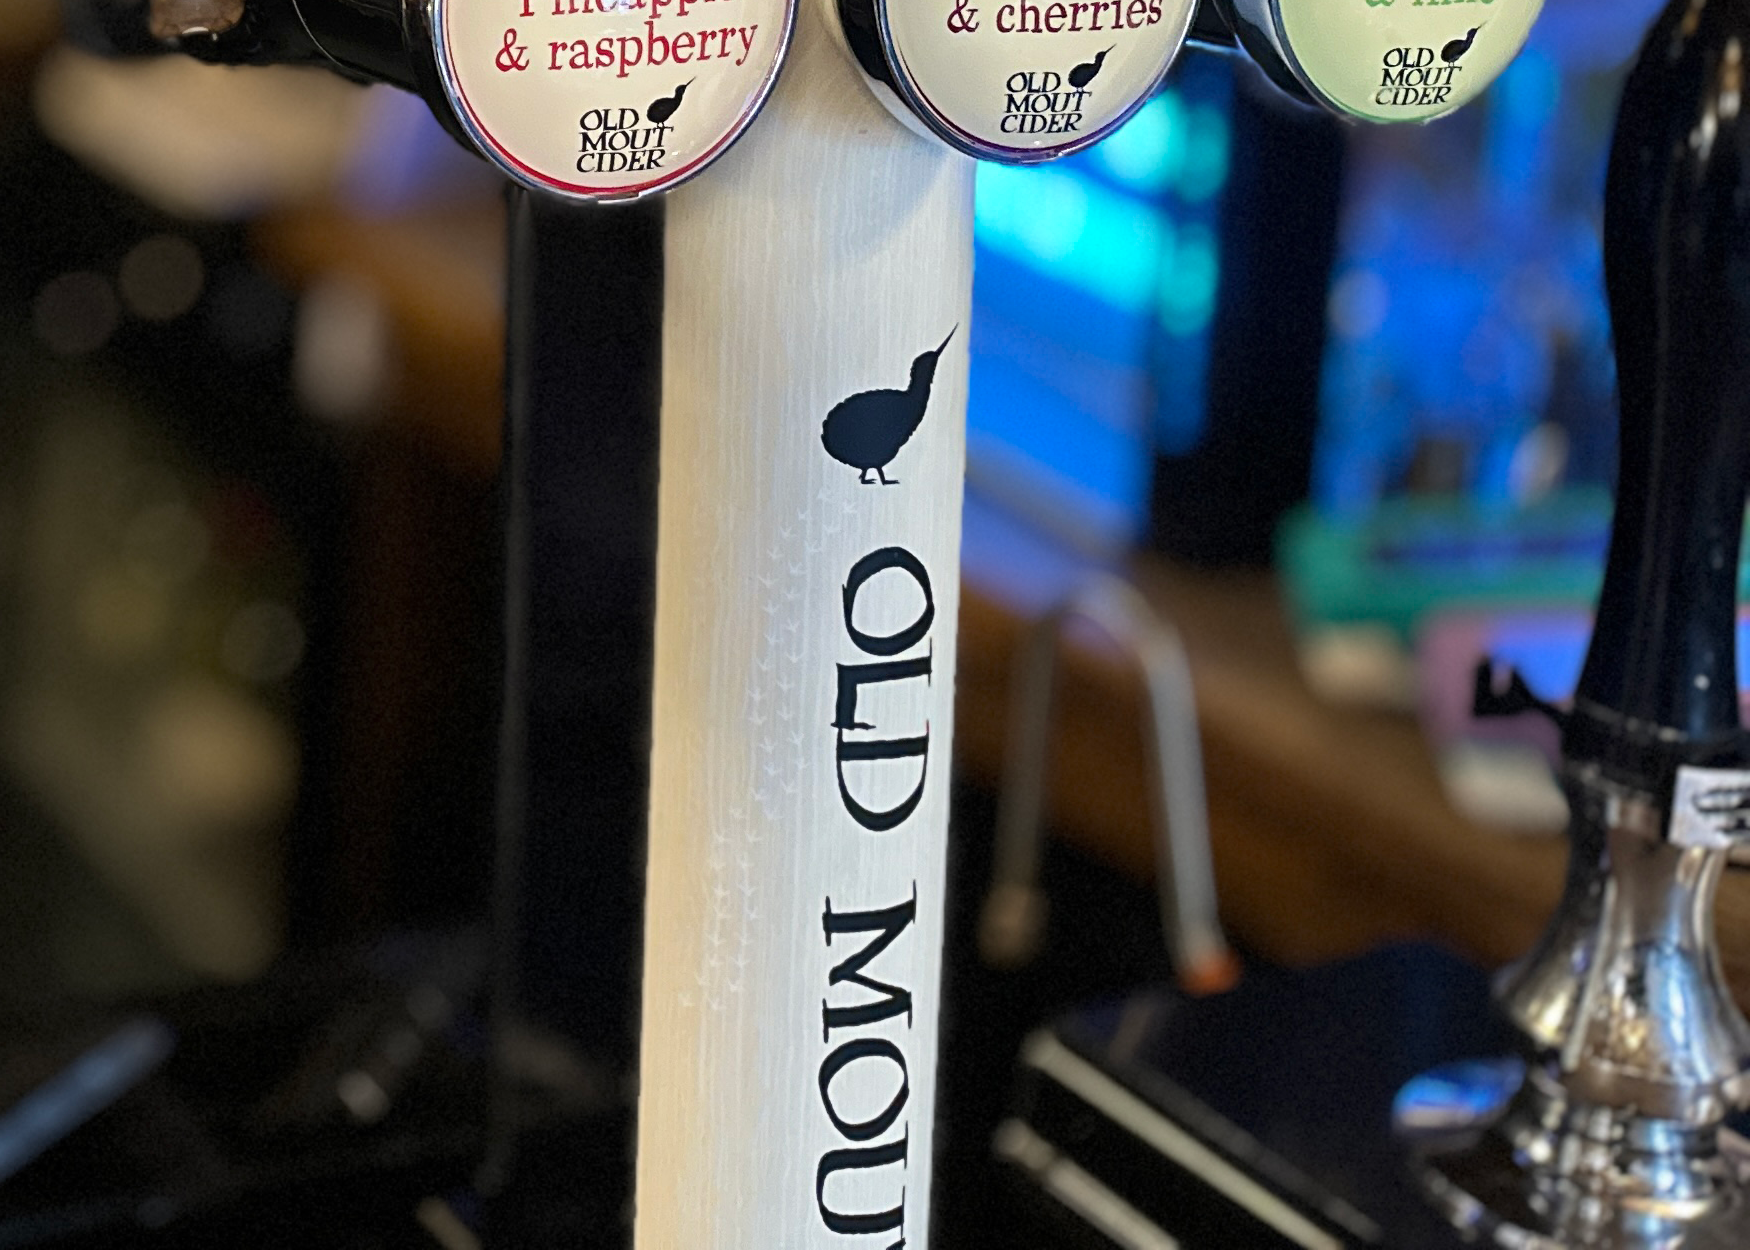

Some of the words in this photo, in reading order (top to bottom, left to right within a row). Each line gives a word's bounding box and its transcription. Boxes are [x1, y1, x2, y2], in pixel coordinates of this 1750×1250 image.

[495, 28, 530, 73] &
[548, 20, 759, 77] raspberry
[1383, 48, 1434, 68] OLD
[1006, 72, 1060, 93] OLD
[1381, 66, 1462, 87] MOUT
[1004, 91, 1092, 114] MOUT
[1375, 86, 1452, 105] CIDER
[579, 108, 639, 130] OLD
[1000, 112, 1082, 133] CIDER
[579, 126, 673, 152] MOUT
[576, 149, 665, 173] CIDER
[831, 546, 935, 833] OLD
[815, 879, 917, 1250] MOU
